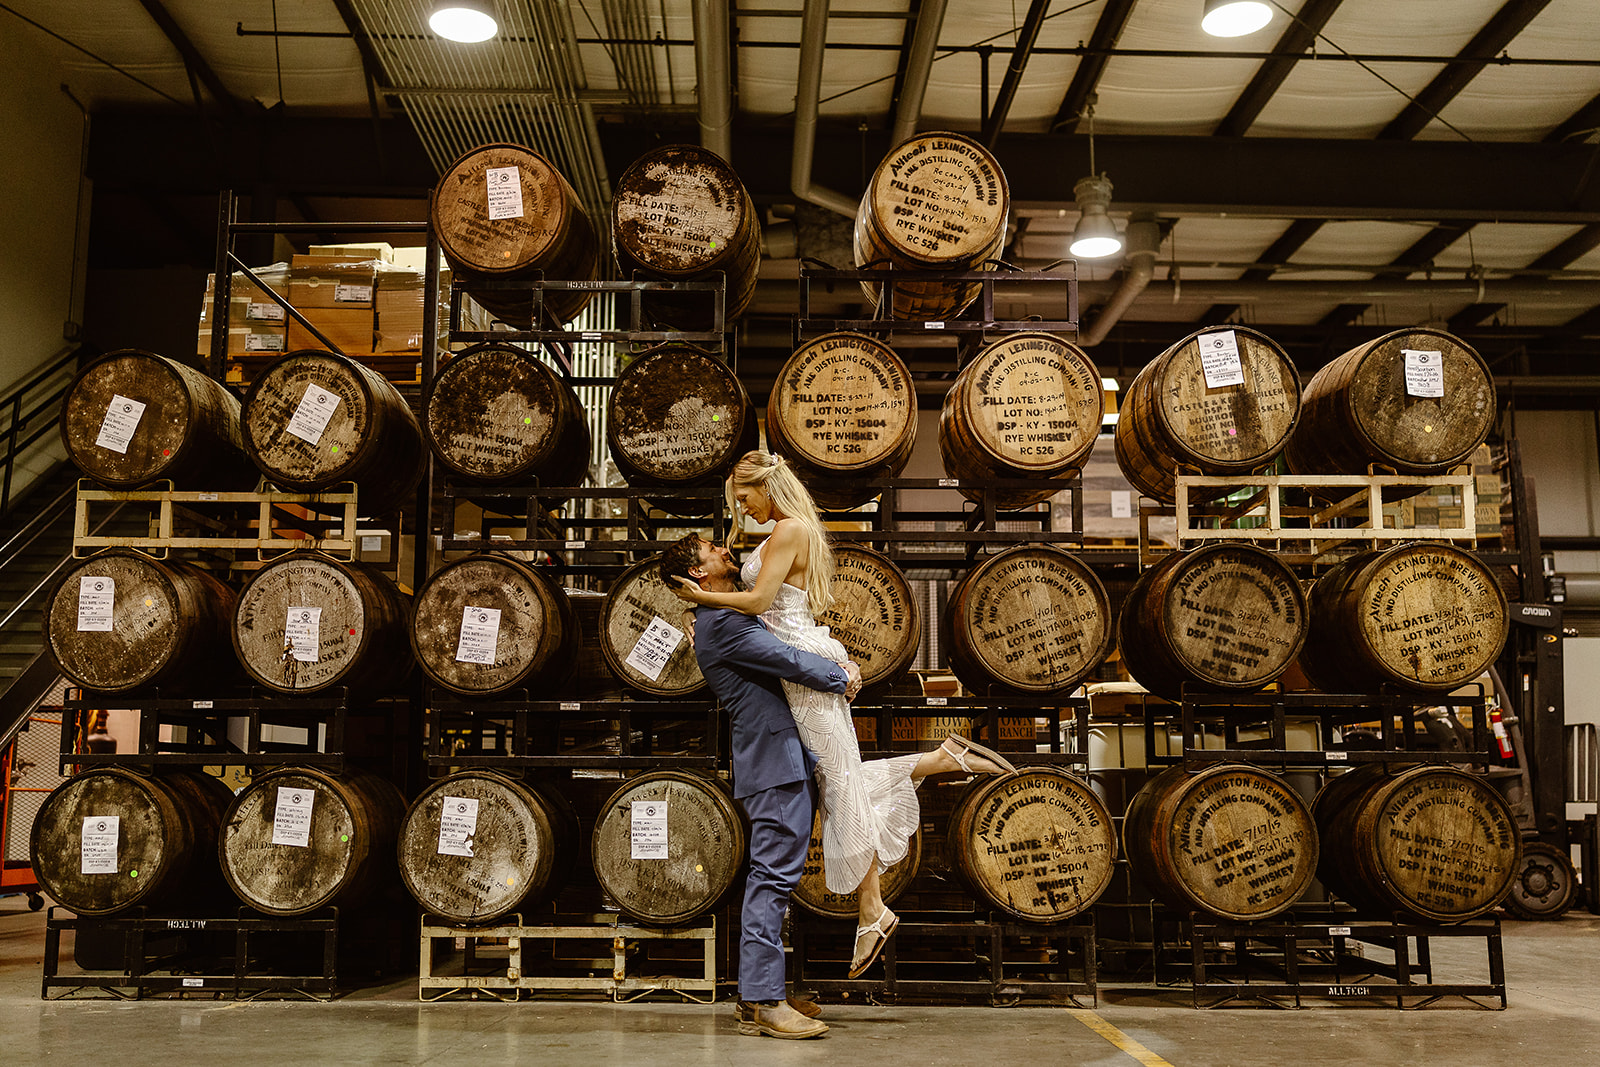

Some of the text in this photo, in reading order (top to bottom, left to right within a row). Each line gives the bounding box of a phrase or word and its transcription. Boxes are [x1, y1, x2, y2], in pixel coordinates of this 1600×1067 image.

[919, 155, 986, 201] DISTILLING COMPANY
[932, 141, 981, 165] LEXINGTON
[980, 163, 998, 206] BREWING
[890, 179, 940, 200] FILL DATE:
[651, 201, 679, 213] DATE:
[904, 196, 942, 214] LOT NO:
[644, 213, 663, 222] LOT
[683, 231, 710, 243] 15004
[896, 219, 961, 245] RYE WHISKEY
[664, 240, 706, 254] WHISKEY
[814, 354, 889, 390] DISTILLING COMPANY
[821, 340, 876, 355] LEXINGTON
[875, 350, 903, 391] BREWING
[1003, 356, 1080, 390] DISTILLING COMPANY
[1008, 341, 1064, 356] LEXINGTON
[1063, 351, 1094, 391] BREWING
[792, 394, 846, 403] FILL DATE:
[983, 396, 1037, 406] FILL DATE:
[1173, 399, 1209, 413] CASTLE
[813, 406, 852, 415] LOT NO:
[1004, 409, 1044, 418] LOT NO:
[997, 420, 1079, 431] DSP KY 15004
[638, 437, 657, 447] DSP
[666, 434, 679, 443] KY
[812, 431, 879, 441] RYE WHISKEY
[1004, 432, 1072, 443] RYE WHISKEY
[475, 443, 518, 458] WHISKEY
[643, 444, 715, 459] MALT WHISKEY
[1020, 446, 1034, 455] RC
[992, 560, 1087, 597] LEXINGTON BREWING
[1391, 556, 1446, 575] LEXINGTON
[1450, 559, 1488, 597] BREWING
[838, 559, 903, 631] LEXINGTON BREWING
[993, 575, 1032, 604] DISTILLING
[1193, 581, 1209, 597] AND
[1385, 571, 1473, 618] AND DISTILLING COMPANY
[870, 586, 889, 626] COMPANY
[983, 630, 1005, 642] FILL
[1006, 619, 1036, 634] DATE:
[1196, 617, 1217, 629] LOT
[1380, 614, 1434, 634] FILL DATE:
[1006, 635, 1026, 648] LOT
[1028, 629, 1047, 640] NO:
[1186, 628, 1207, 639] DSP
[1403, 624, 1444, 642] LOT NO:
[1005, 630, 1084, 663] DSP 15004
[1400, 630, 1483, 658] DSP KY 15004
[1433, 644, 1480, 663] WHISKEY
[1037, 643, 1082, 666] WHISKEY
[1212, 648, 1260, 668] WHISKEY
[1430, 668, 1444, 679] RC
[1000, 717, 1032, 727] OWN
[894, 728, 914, 739] NCH
[1000, 728, 1033, 738] RANCH
[1005, 779, 1063, 797] LEXINGTON
[1064, 787, 1099, 827] BREWING
[1195, 778, 1250, 803] LEXINGTON
[1253, 780, 1295, 815] BREWING
[994, 796, 1085, 839] AND DISTILLING COMPANY
[1199, 794, 1282, 827] DISTILLING COMPANY
[1402, 796, 1495, 845] AND DISTILLING COMPANY
[1485, 802, 1509, 849] BREWING
[987, 839, 1041, 855] FILL DATE:
[1390, 829, 1411, 841] FILL
[1415, 834, 1446, 848] DATE:
[1008, 855, 1028, 866] LOT
[1031, 853, 1050, 863] NO:
[1192, 851, 1213, 866] FILL
[1213, 839, 1245, 857] DATE:
[1215, 857, 1235, 872] LOT
[1238, 850, 1257, 862] NO:
[1407, 847, 1451, 863] LOT NO:
[1005, 861, 1089, 881] DSP 15004
[1214, 849, 1295, 888] DSP 15004
[1249, 864, 1294, 889] WHISKEY
[1399, 859, 1485, 886] DSP KY 15004
[1037, 876, 1085, 891] WHISKEY
[1428, 880, 1477, 898] WHISKEY
[1033, 898, 1047, 907] RC
[1247, 894, 1262, 905] RC
[1329, 986, 1370, 997] ALLTECH
